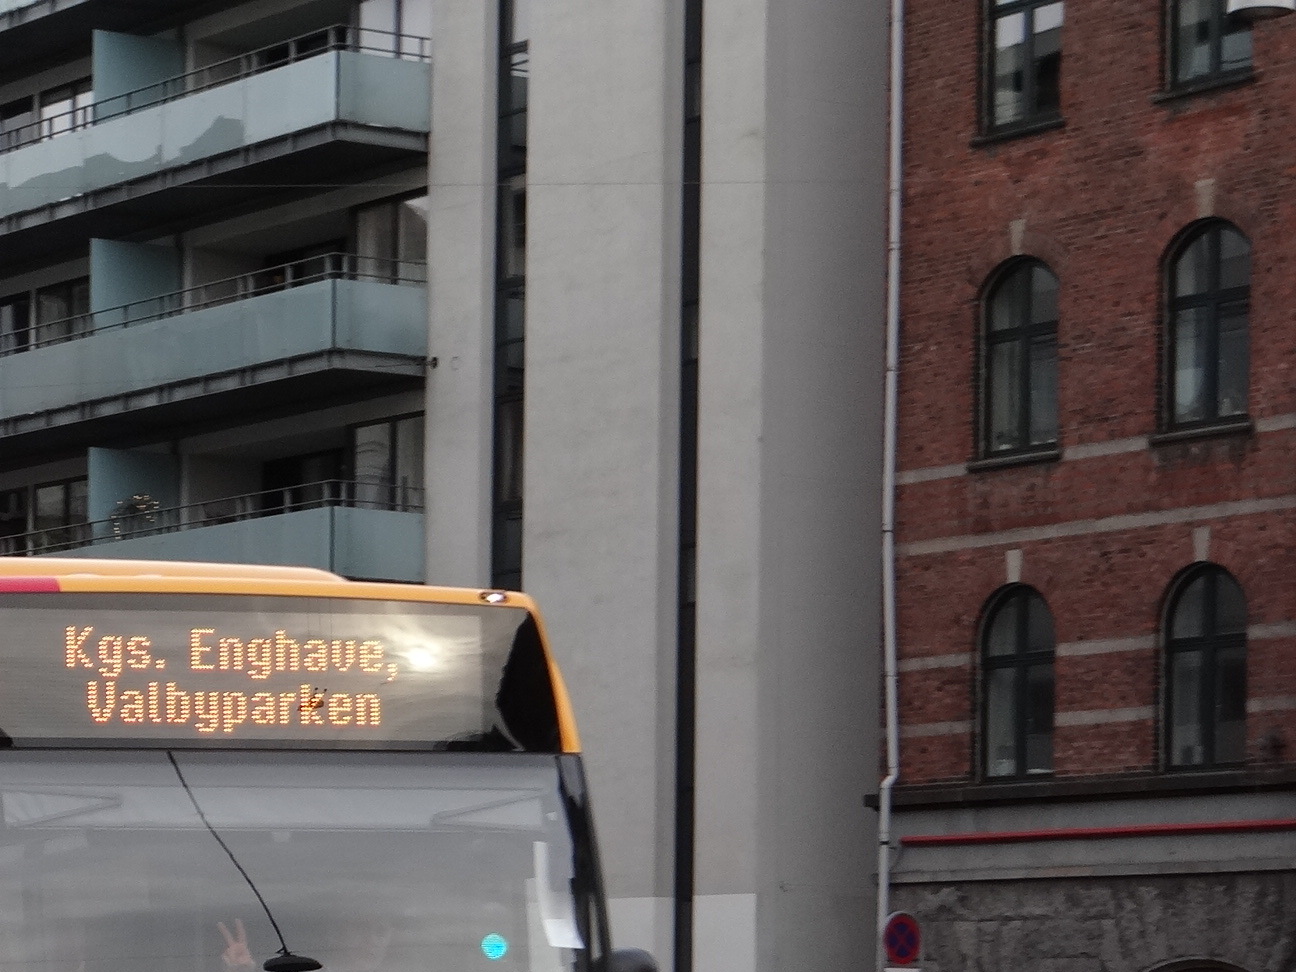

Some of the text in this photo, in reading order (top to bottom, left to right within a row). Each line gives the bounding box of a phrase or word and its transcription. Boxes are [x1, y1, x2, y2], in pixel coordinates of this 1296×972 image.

[64, 626, 398, 681] Kgs. Enghave,
[86, 680, 383, 732] Valbyparken
